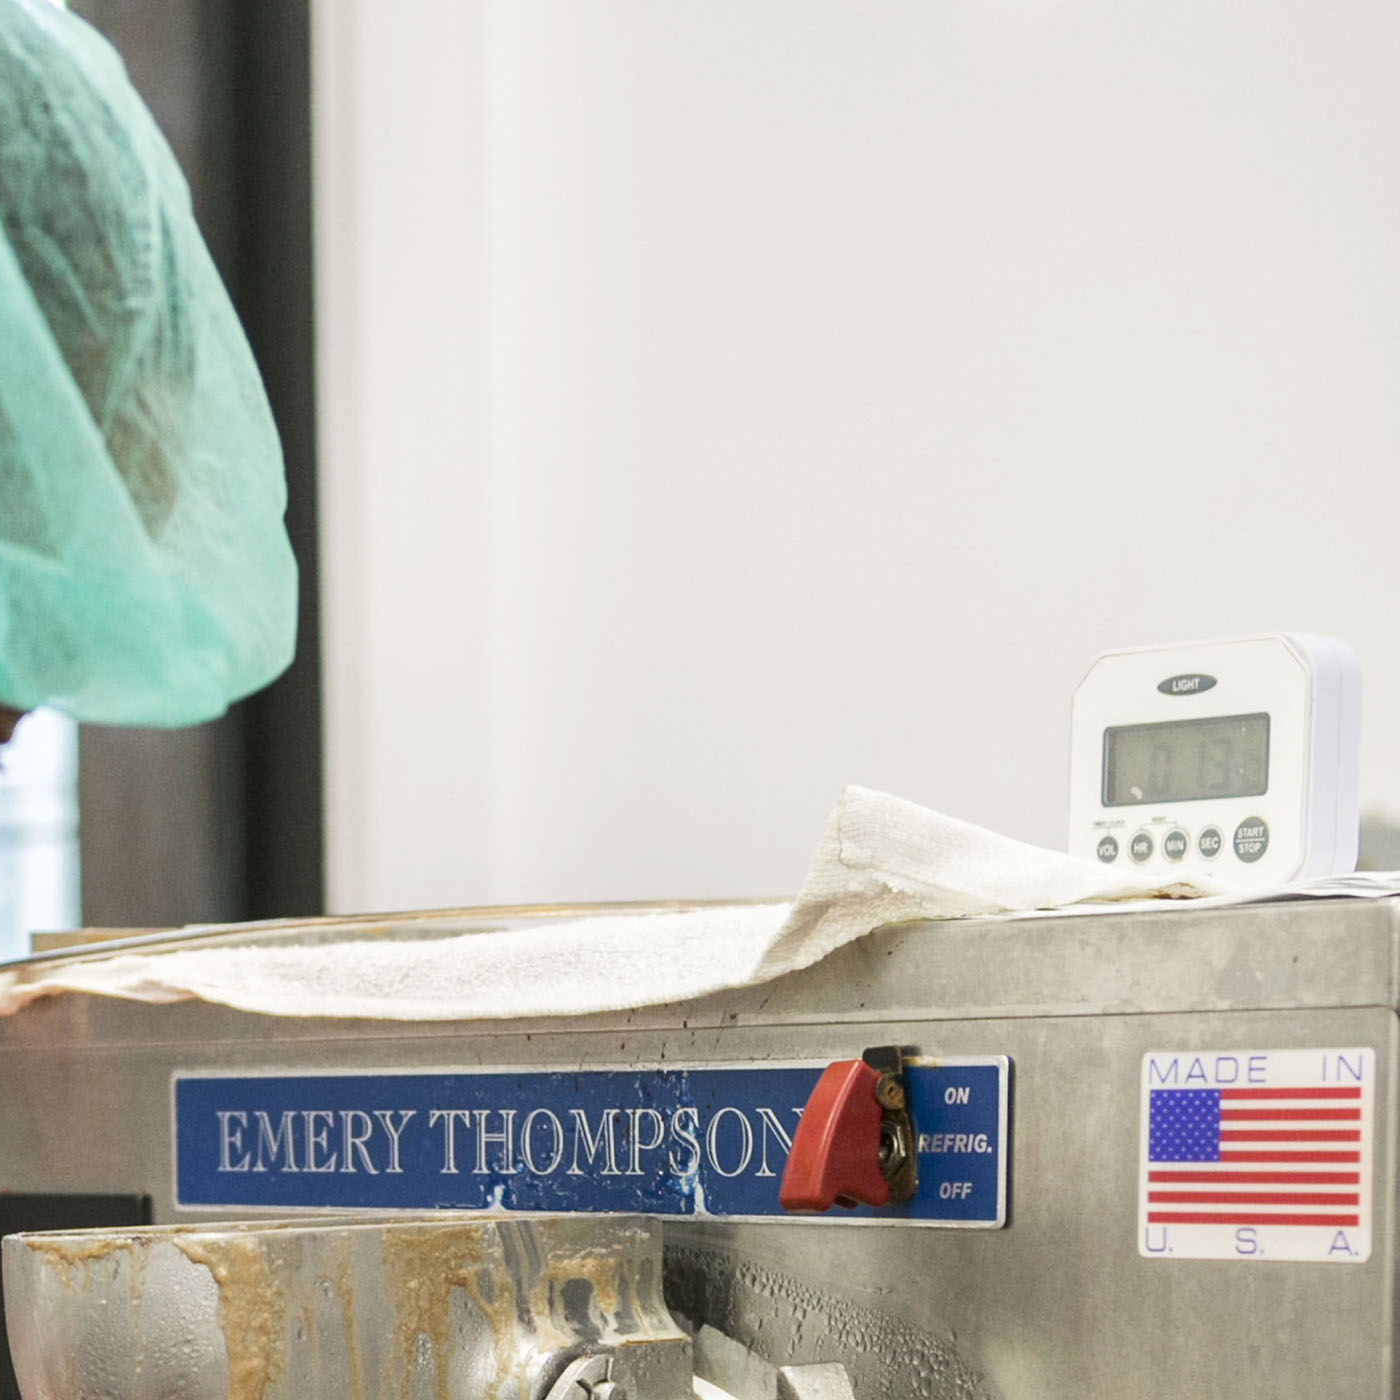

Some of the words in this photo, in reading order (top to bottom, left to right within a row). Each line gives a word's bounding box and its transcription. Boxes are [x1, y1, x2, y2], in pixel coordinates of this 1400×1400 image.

[1172, 678, 1200, 692] LIGHT
[1237, 827, 1264, 838] START
[1099, 844, 1117, 856] VOL
[1133, 841, 1149, 853] HR
[1167, 839, 1184, 851] MIN
[1200, 837, 1219, 849] SEC
[1238, 842, 1261, 854] STOP
[1148, 1056, 1268, 1085] MADE
[1322, 1054, 1363, 1082] IN
[944, 1087, 970, 1104] ON
[216, 1110, 417, 1174] EMERY
[429, 1107, 804, 1177] THOMPSON
[918, 1134, 992, 1153] REFRIG.
[939, 1182, 972, 1199] OFF
[1145, 1227, 1173, 1252] U.
[1236, 1227, 1264, 1254] S.
[1328, 1230, 1359, 1256] A.
